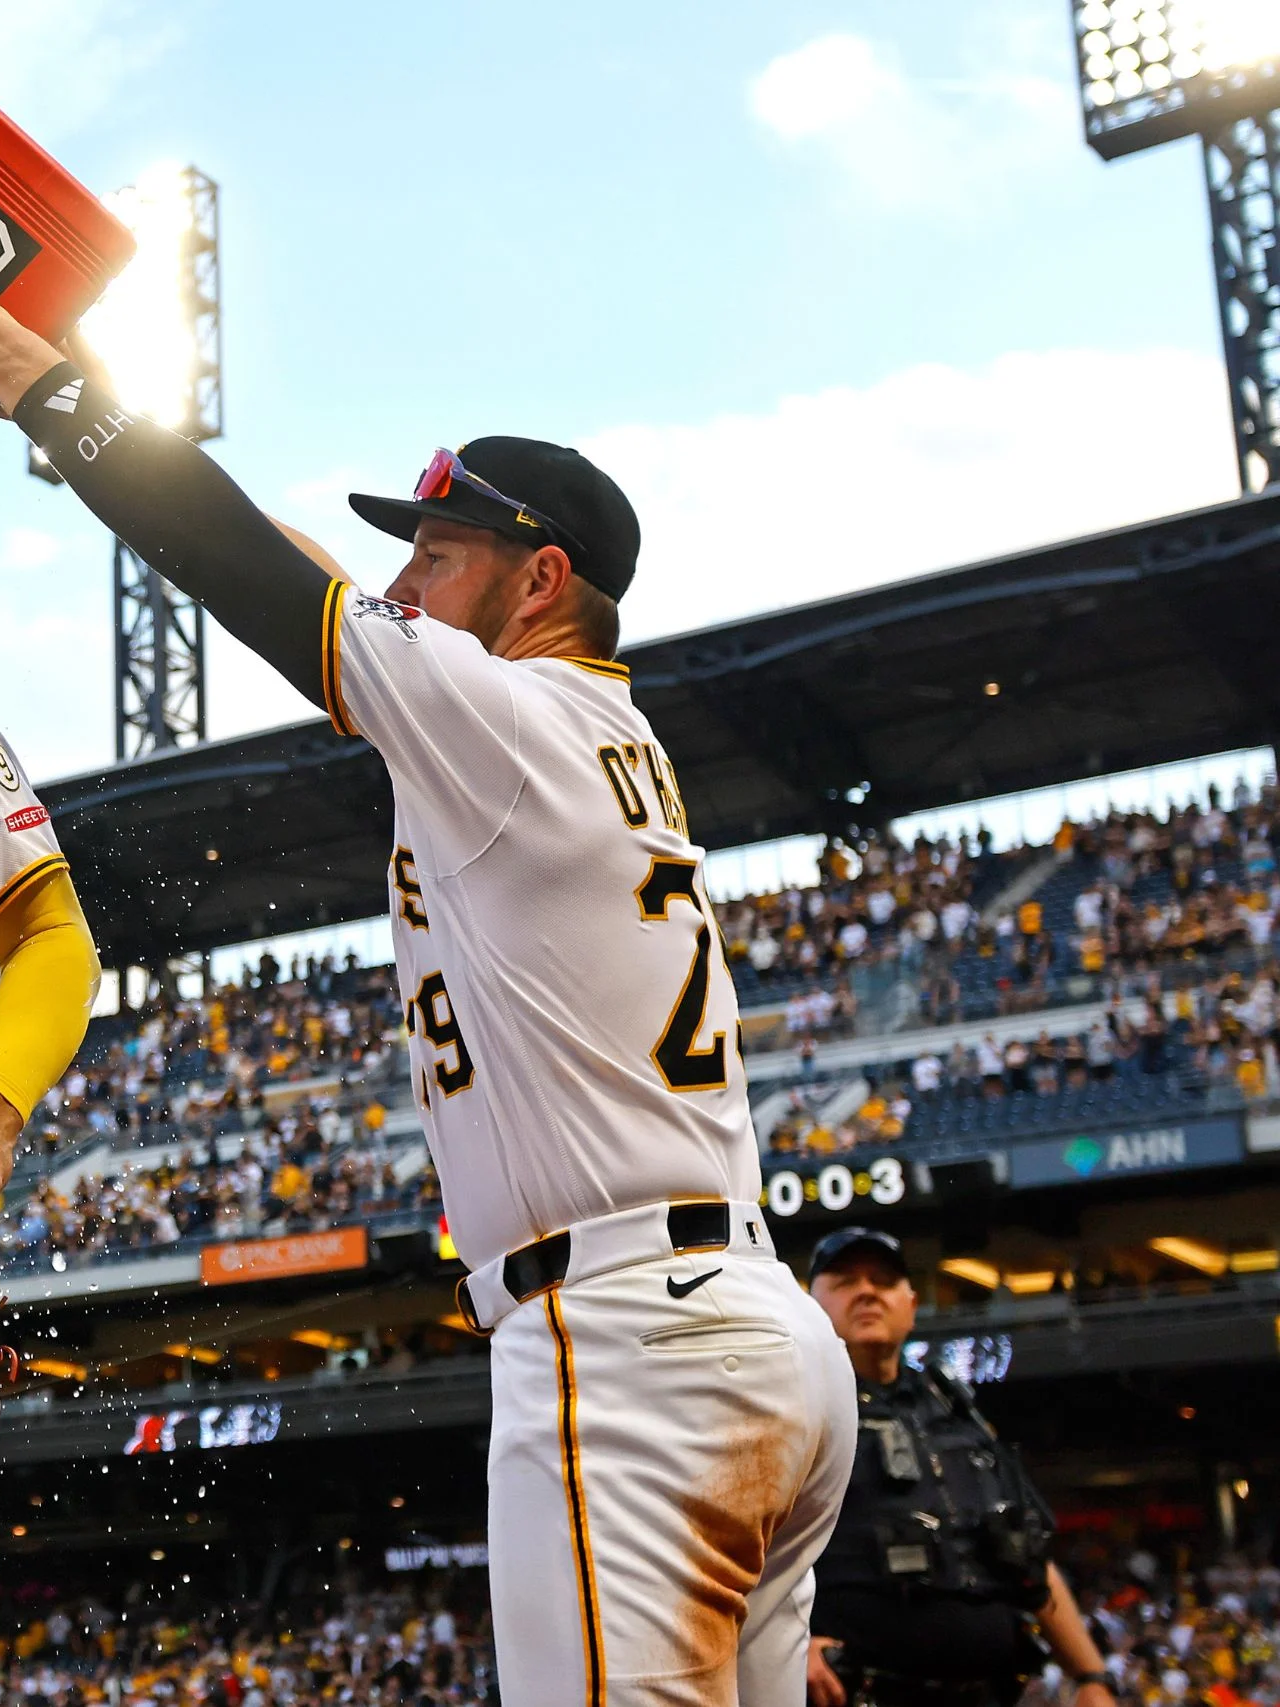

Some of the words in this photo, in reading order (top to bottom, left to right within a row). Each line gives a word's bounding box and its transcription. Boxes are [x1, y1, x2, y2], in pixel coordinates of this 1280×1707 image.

[7, 807, 49, 830] SHEETZ
[633, 856, 747, 1093] 2
[1107, 1130, 1187, 1170] AHN
